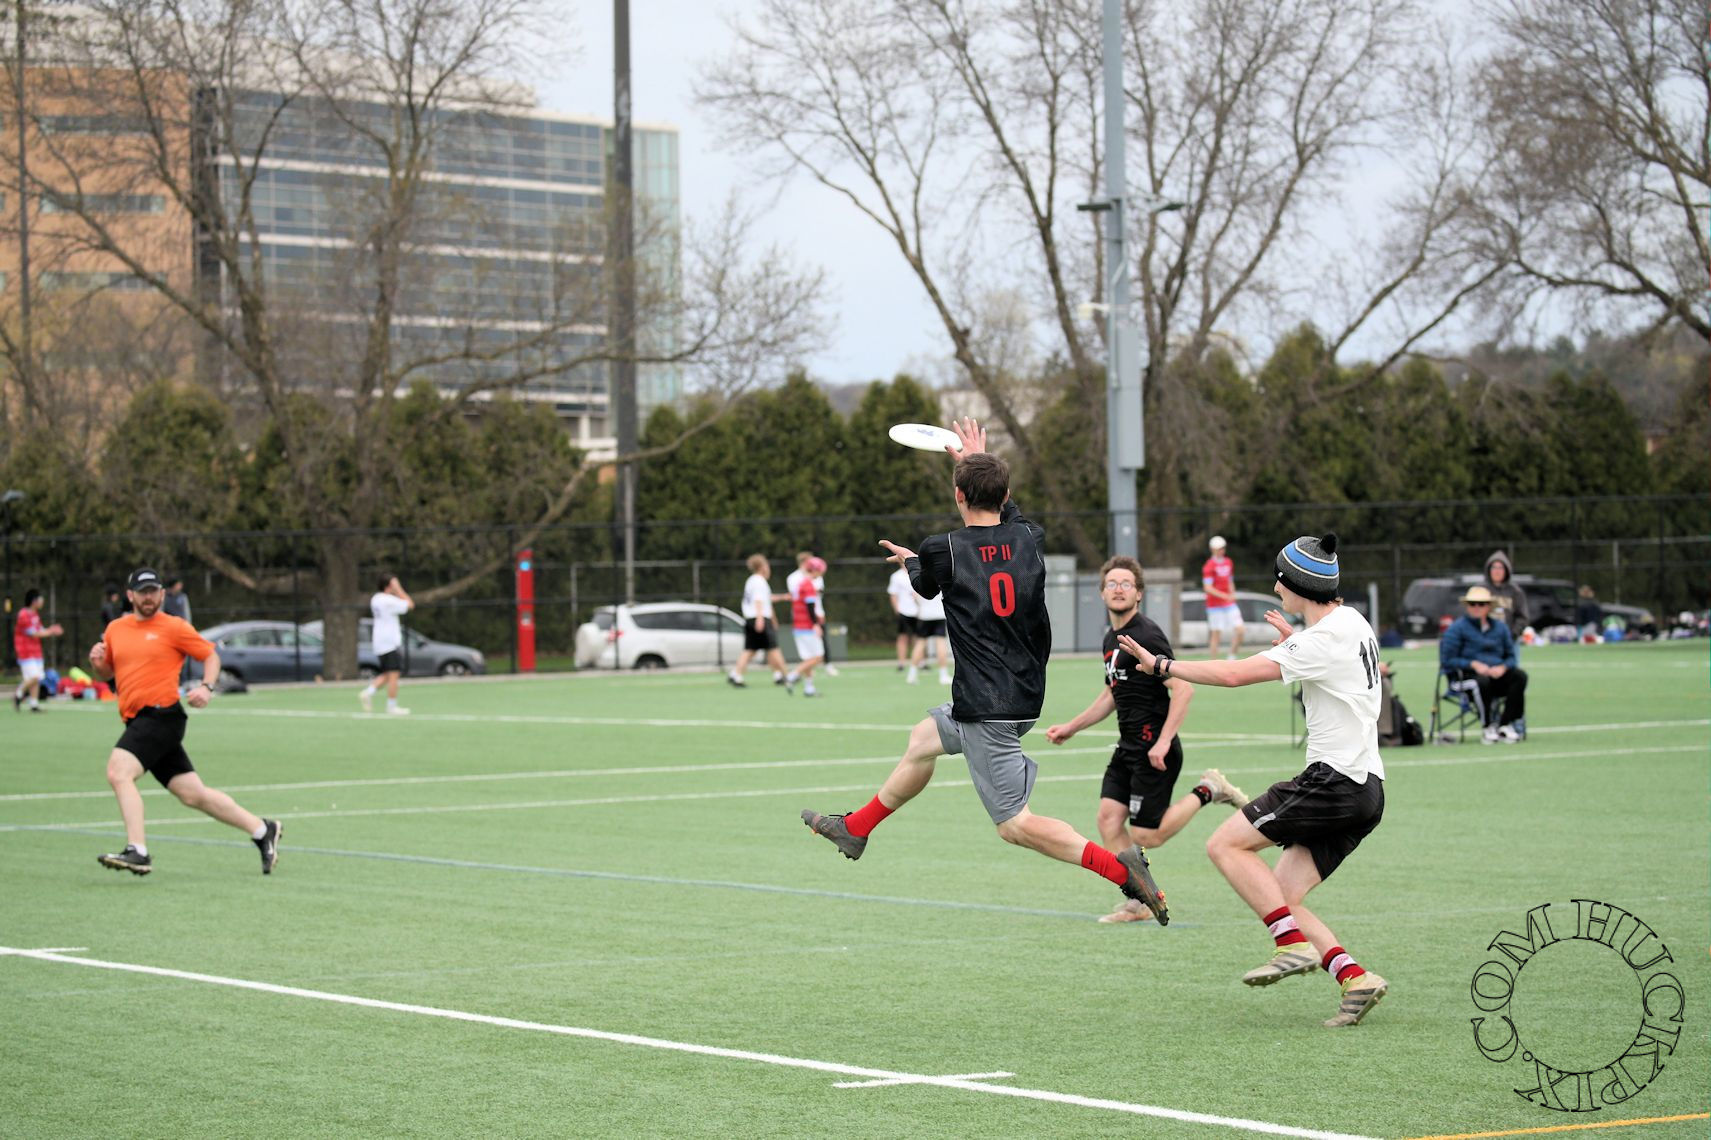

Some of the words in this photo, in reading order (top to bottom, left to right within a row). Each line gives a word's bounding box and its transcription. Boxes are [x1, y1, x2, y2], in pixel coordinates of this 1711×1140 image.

[979, 545, 997, 562] TP
[989, 572, 1015, 617] 0
[1141, 723, 1153, 741] 5
